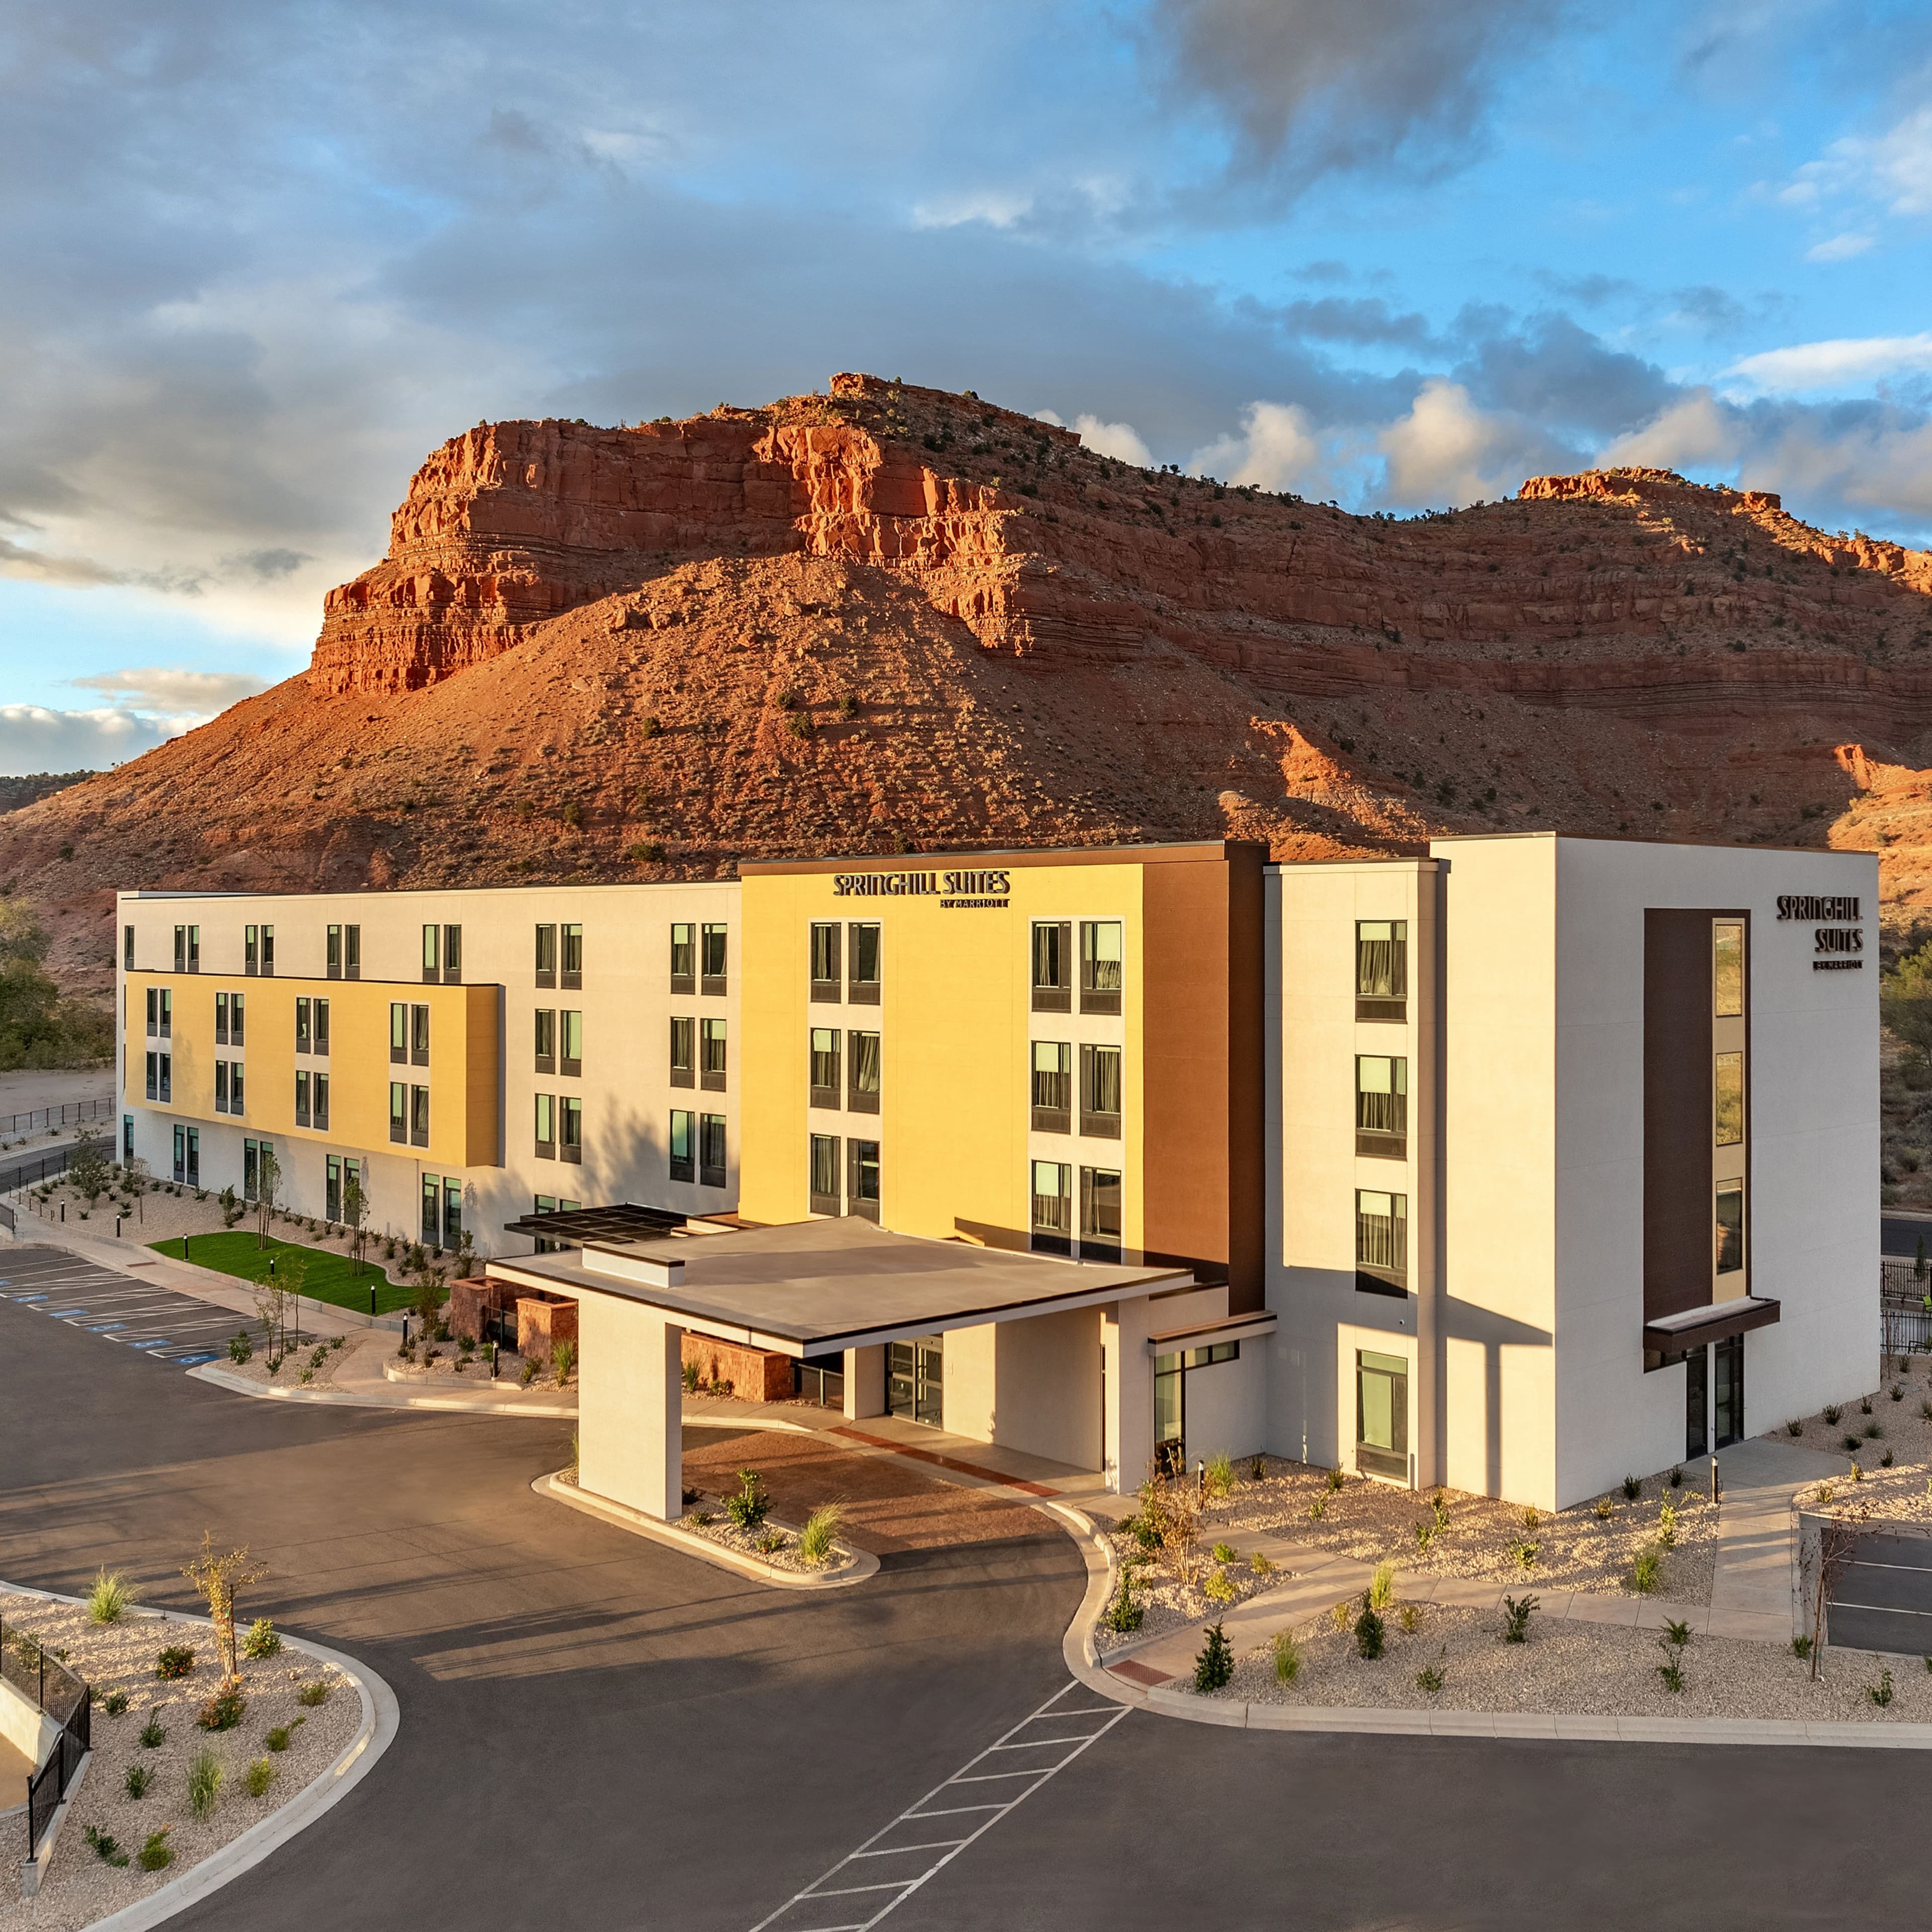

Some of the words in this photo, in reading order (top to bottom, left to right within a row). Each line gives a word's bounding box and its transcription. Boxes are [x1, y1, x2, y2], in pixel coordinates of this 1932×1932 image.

[833, 873, 941, 896] SPRINGHILL
[942, 871, 1010, 895] SUITES
[940, 899, 953, 908] BY
[955, 899, 1010, 908] MARRIOTT
[1777, 896, 1863, 920] SPRINGHILL
[1814, 928, 1863, 952] SUITES
